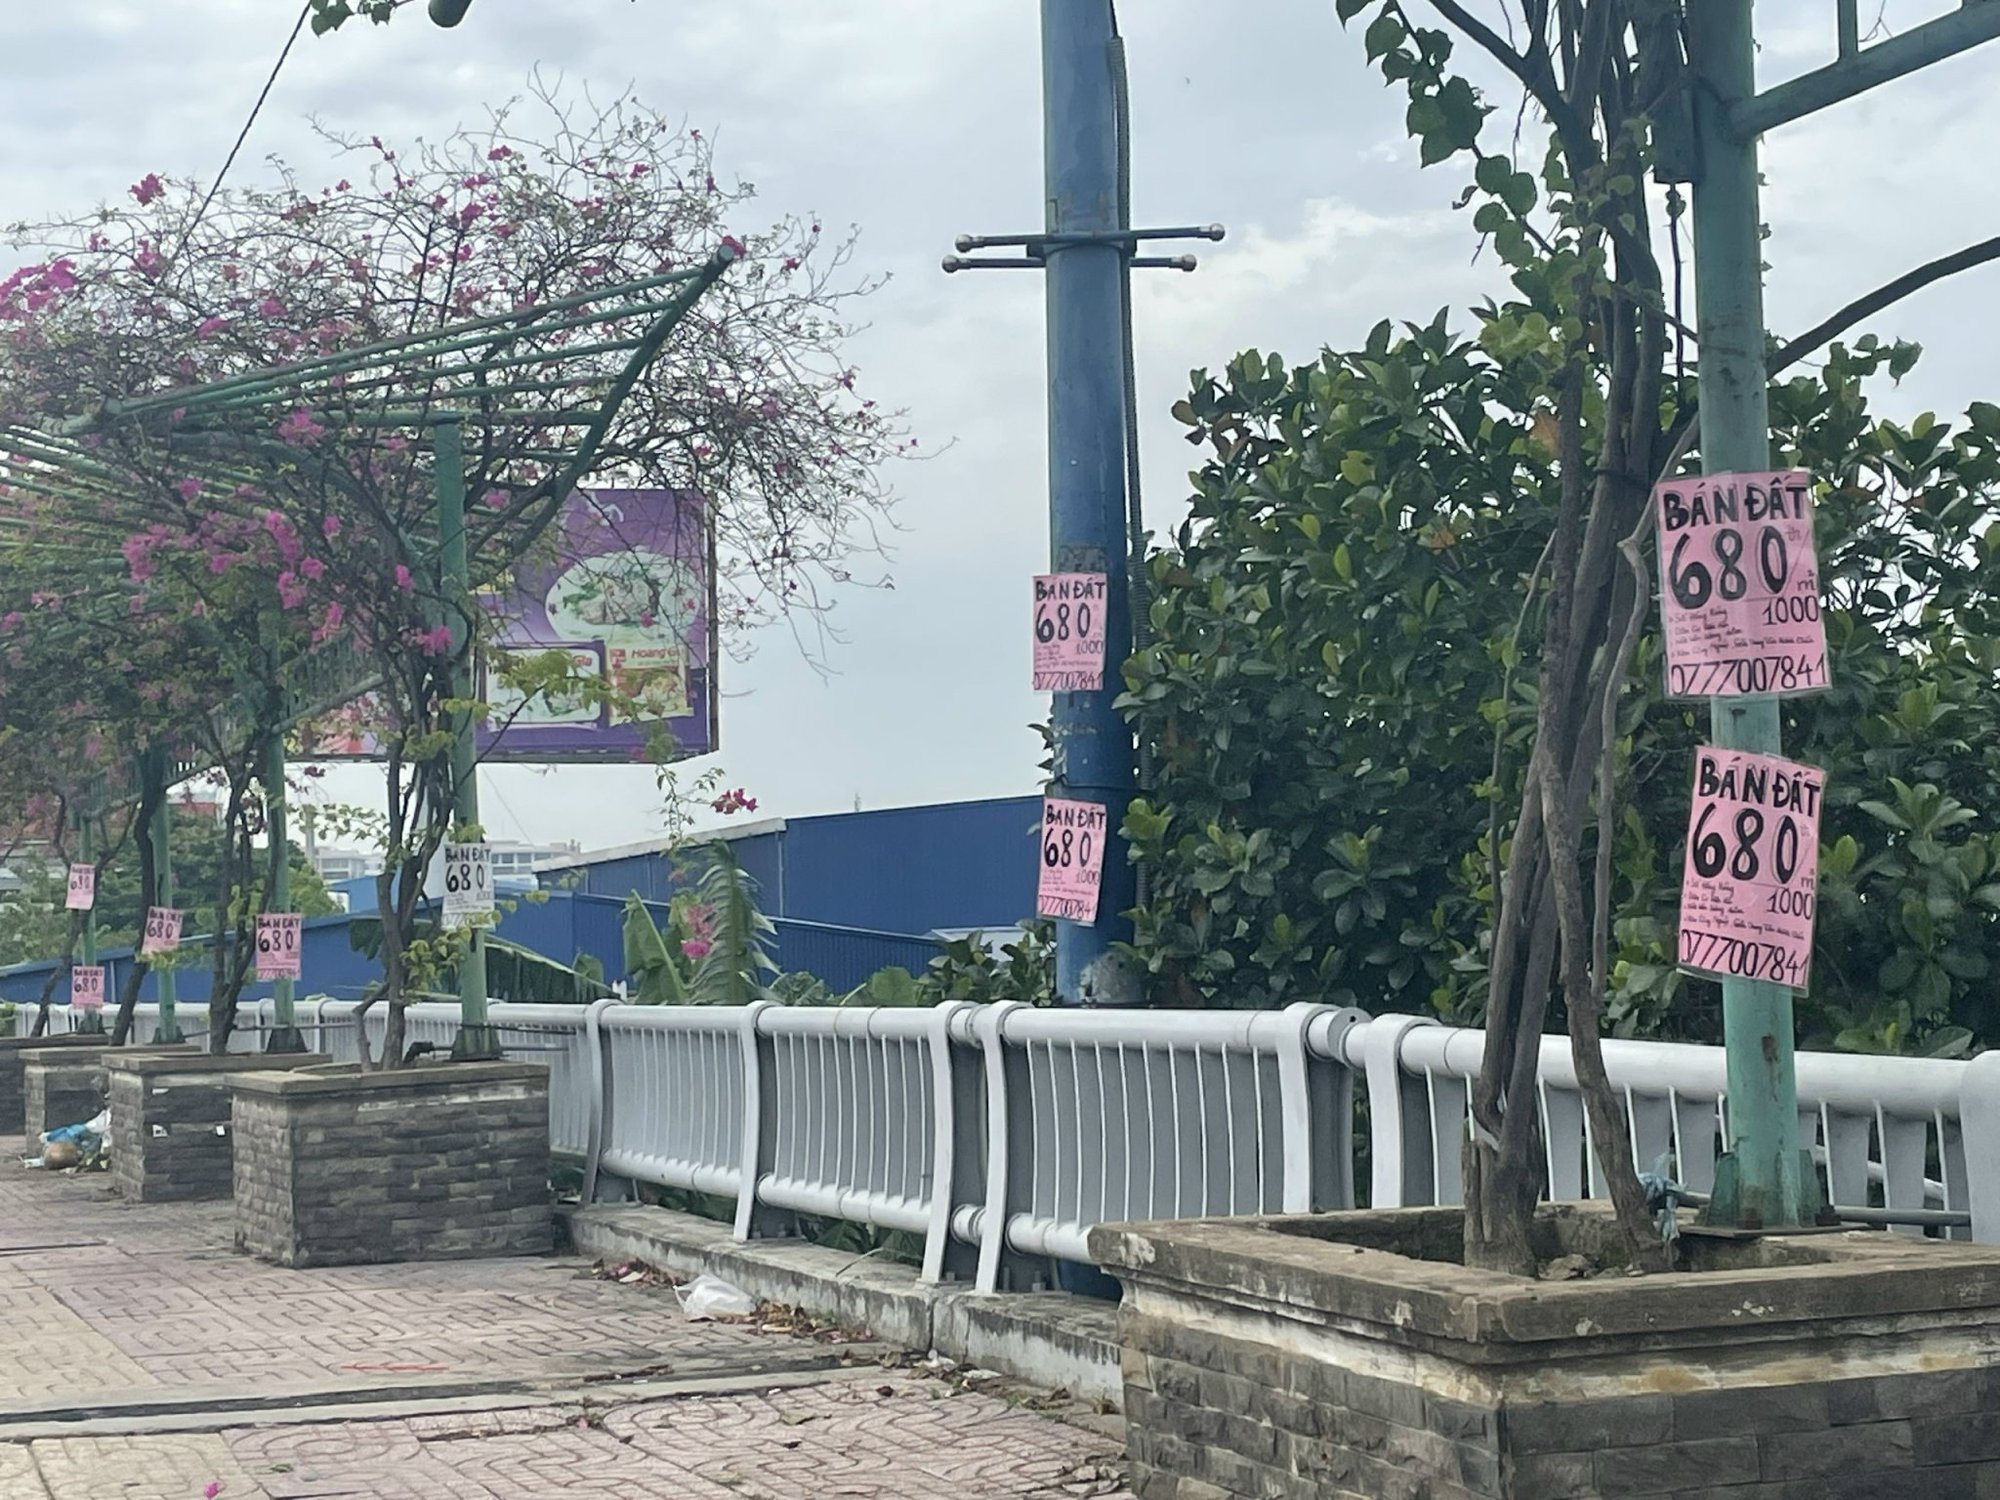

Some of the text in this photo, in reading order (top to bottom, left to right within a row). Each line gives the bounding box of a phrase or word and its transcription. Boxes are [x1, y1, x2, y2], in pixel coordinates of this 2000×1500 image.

[1663, 474, 1807, 531] BÁN ĐẤT
[1669, 526, 1787, 609] 680
[1036, 603, 1091, 643] 680
[1763, 596, 1819, 625] 1000
[1076, 640, 1104, 654] 1000
[1671, 654, 1827, 695] 0777007841
[1699, 756, 1821, 817] BÁN ĐẤT
[1044, 827, 1091, 868] 680
[1692, 802, 1799, 884] 680
[445, 863, 485, 892] 680
[1075, 870, 1100, 886] 1000
[1766, 887, 1814, 920] 1000
[147, 920, 174, 939] 680
[258, 930, 294, 953] 680
[74, 977, 98, 992] 680
